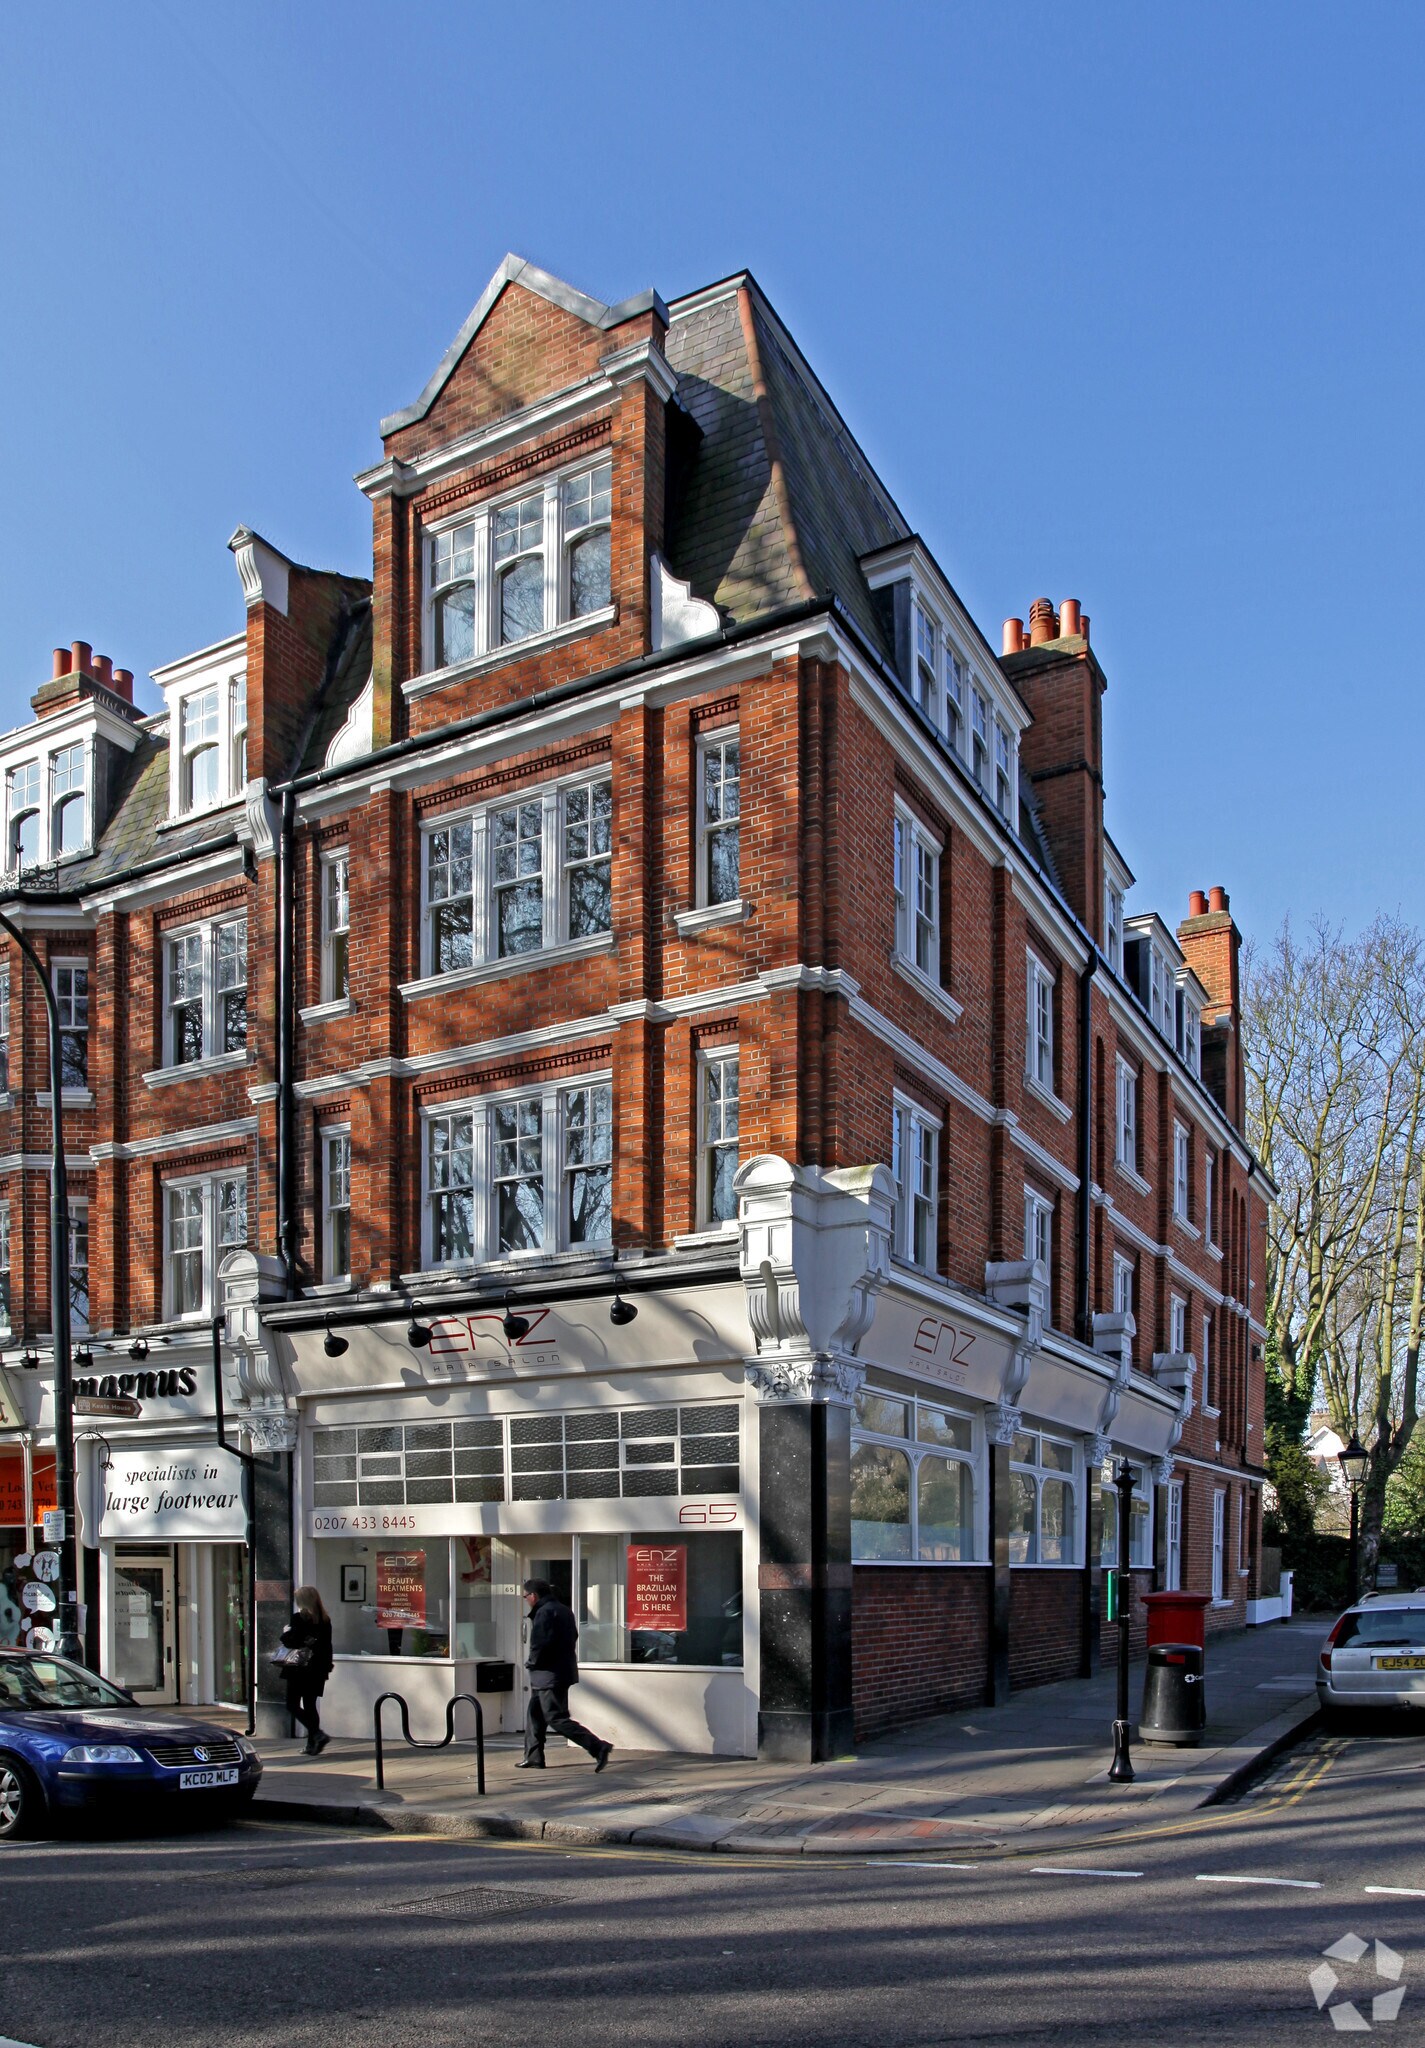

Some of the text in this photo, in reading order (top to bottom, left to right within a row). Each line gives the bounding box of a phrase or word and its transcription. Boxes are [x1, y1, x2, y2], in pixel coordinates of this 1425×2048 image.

[434, 1354, 560, 1372] HAIR SALON
[72, 1367, 197, 1400] magnus
[125, 1464, 218, 1485] specialists in
[38, 1481, 54, 1492] Vet
[106, 1490, 238, 1514] large footwear
[314, 1516, 416, 1530] 0207 433 8445
[680, 1504, 736, 1524] 65
[1382, 1659, 1410, 1667] EJ54
[185, 1771, 234, 1786] KC02 MLF
